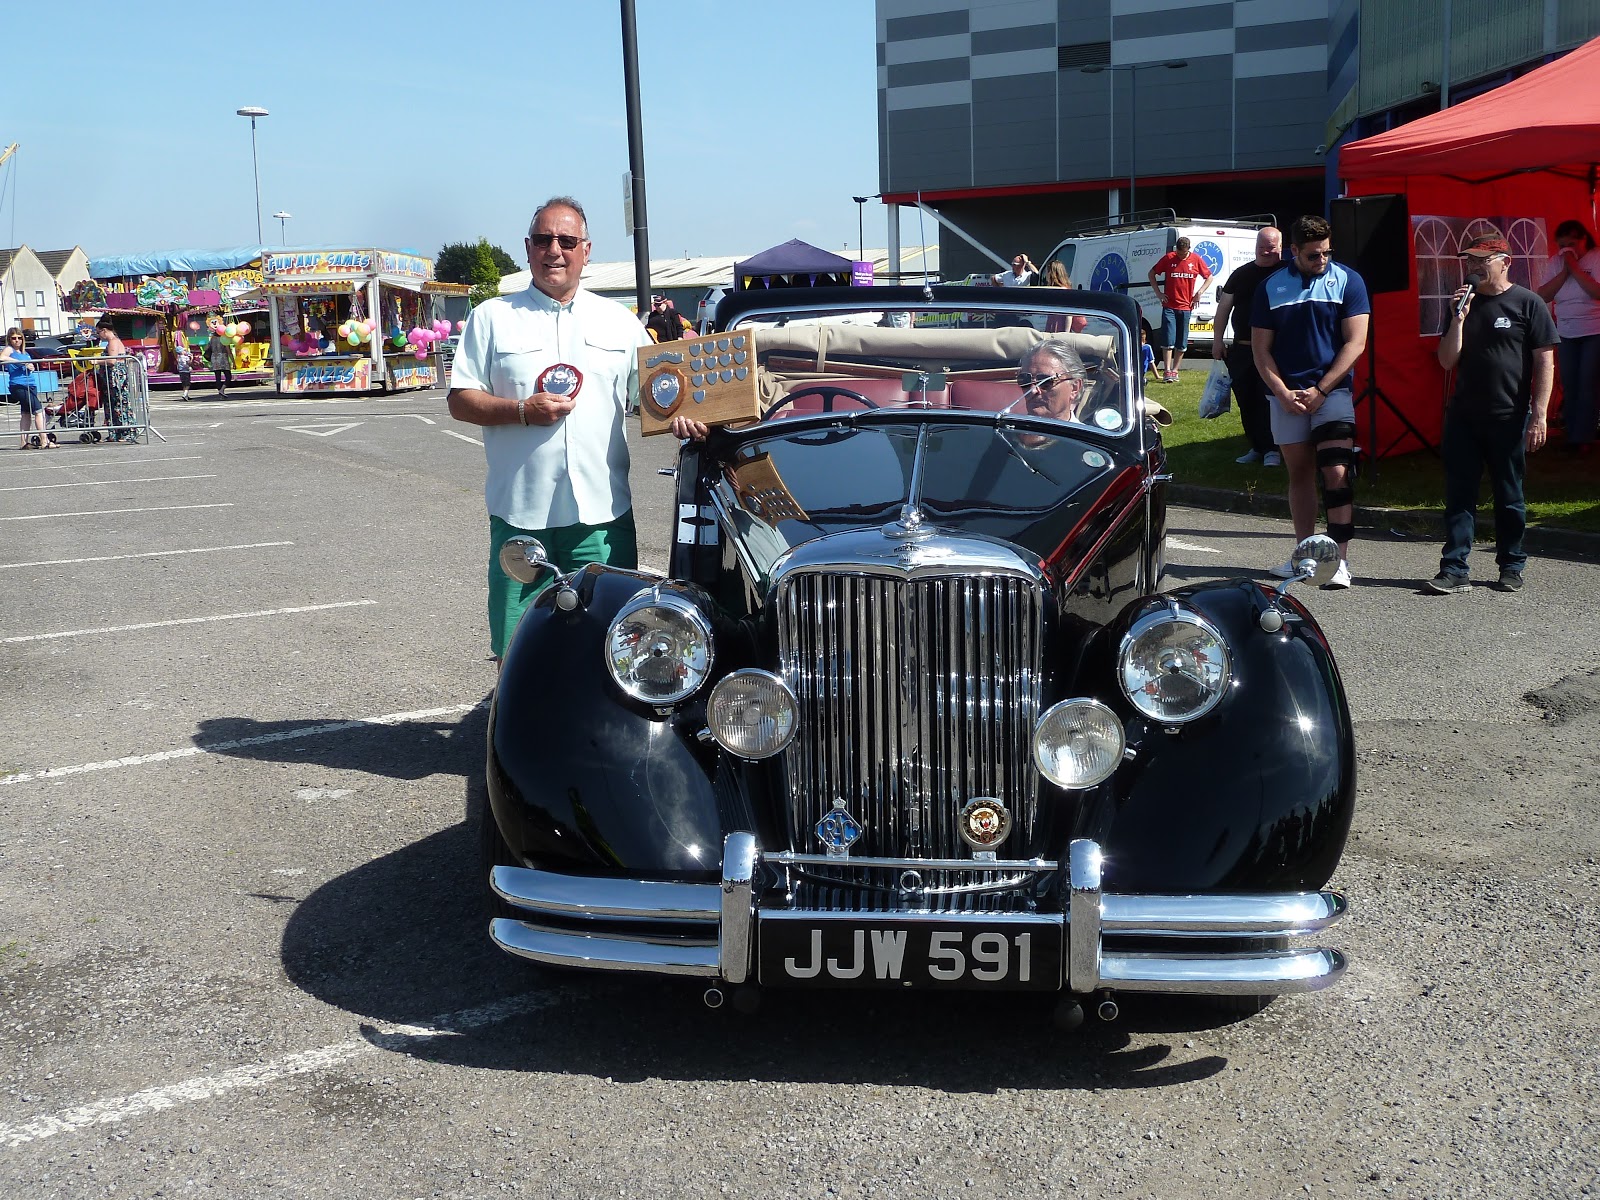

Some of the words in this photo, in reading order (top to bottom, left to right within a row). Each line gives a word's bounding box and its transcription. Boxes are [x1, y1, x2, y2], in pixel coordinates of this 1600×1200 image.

[1195, 241, 1221, 253] BOBATH
[268, 255, 292, 272] FUN
[295, 254, 322, 268] AND
[326, 253, 371, 269] GAMES
[1095, 256, 1127, 276] BOBATH
[219, 269, 264, 284] CIRCUS
[296, 365, 356, 385] PRIZES
[784, 929, 908, 980] JJW
[928, 931, 1031, 982] 591
